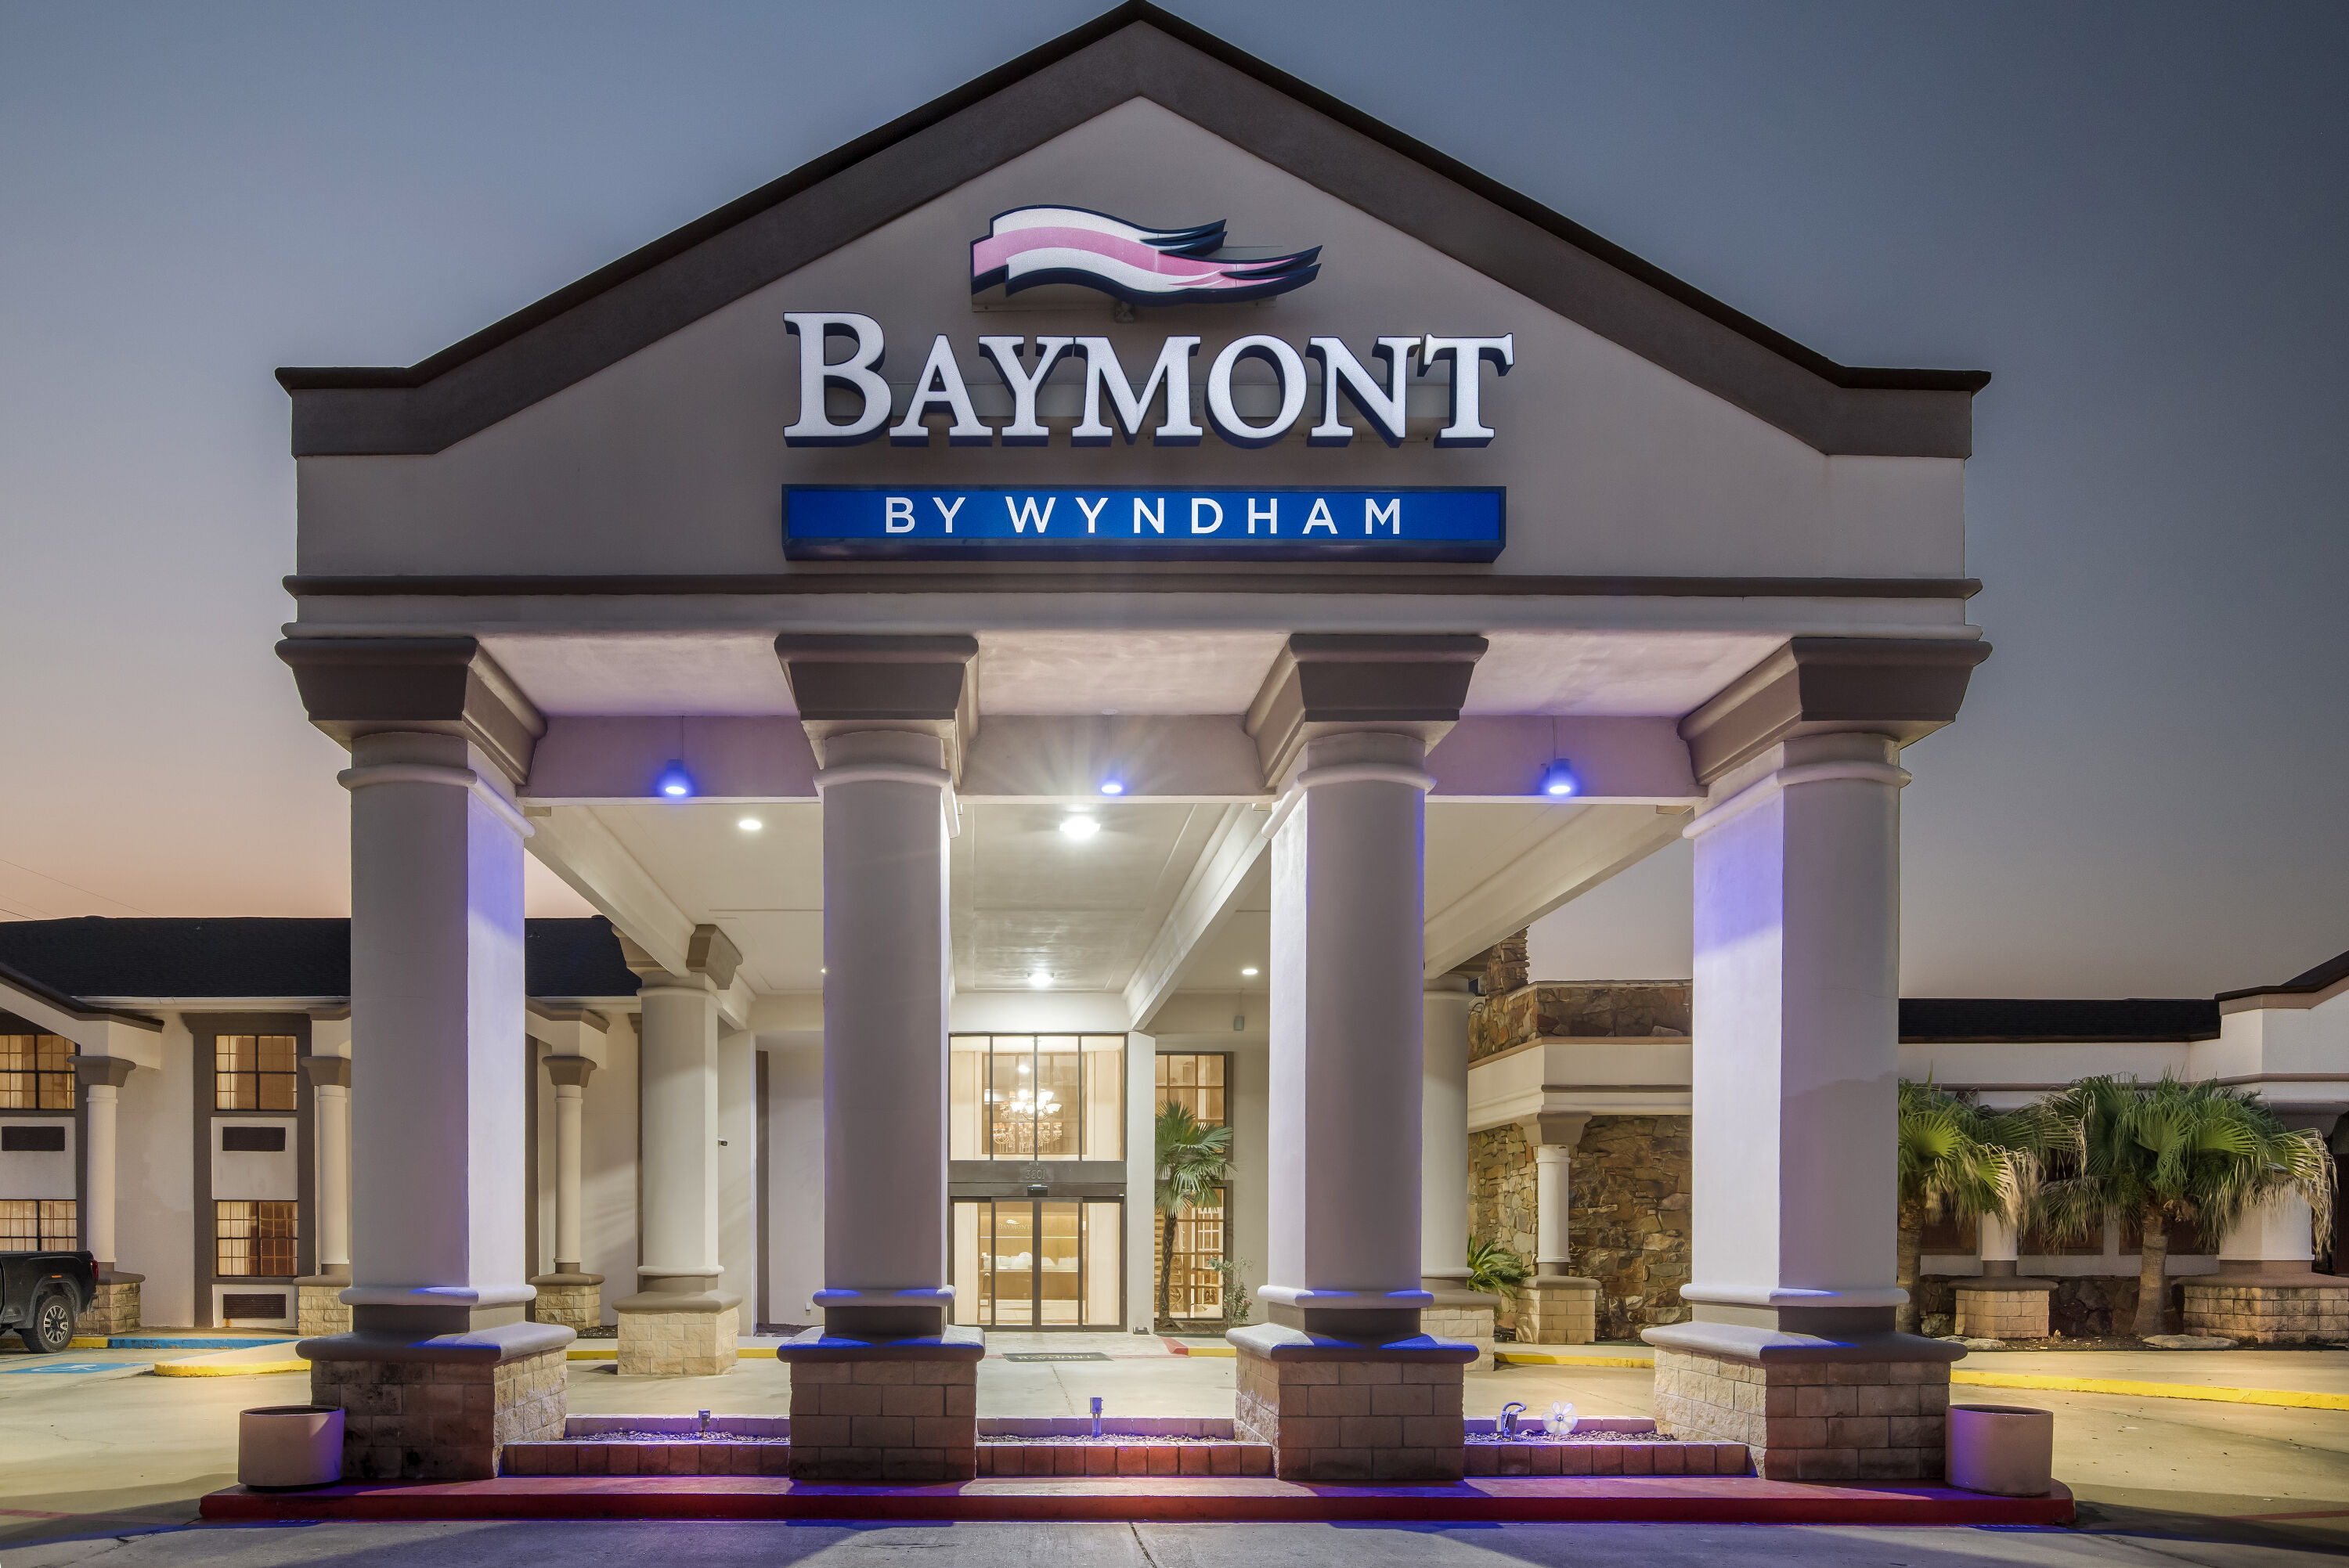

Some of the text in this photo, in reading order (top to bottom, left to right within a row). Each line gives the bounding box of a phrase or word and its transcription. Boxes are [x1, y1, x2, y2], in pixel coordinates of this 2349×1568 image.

[783, 312, 1514, 449] BAYMONT
[885, 496, 1402, 535] BY WYNDHAM
